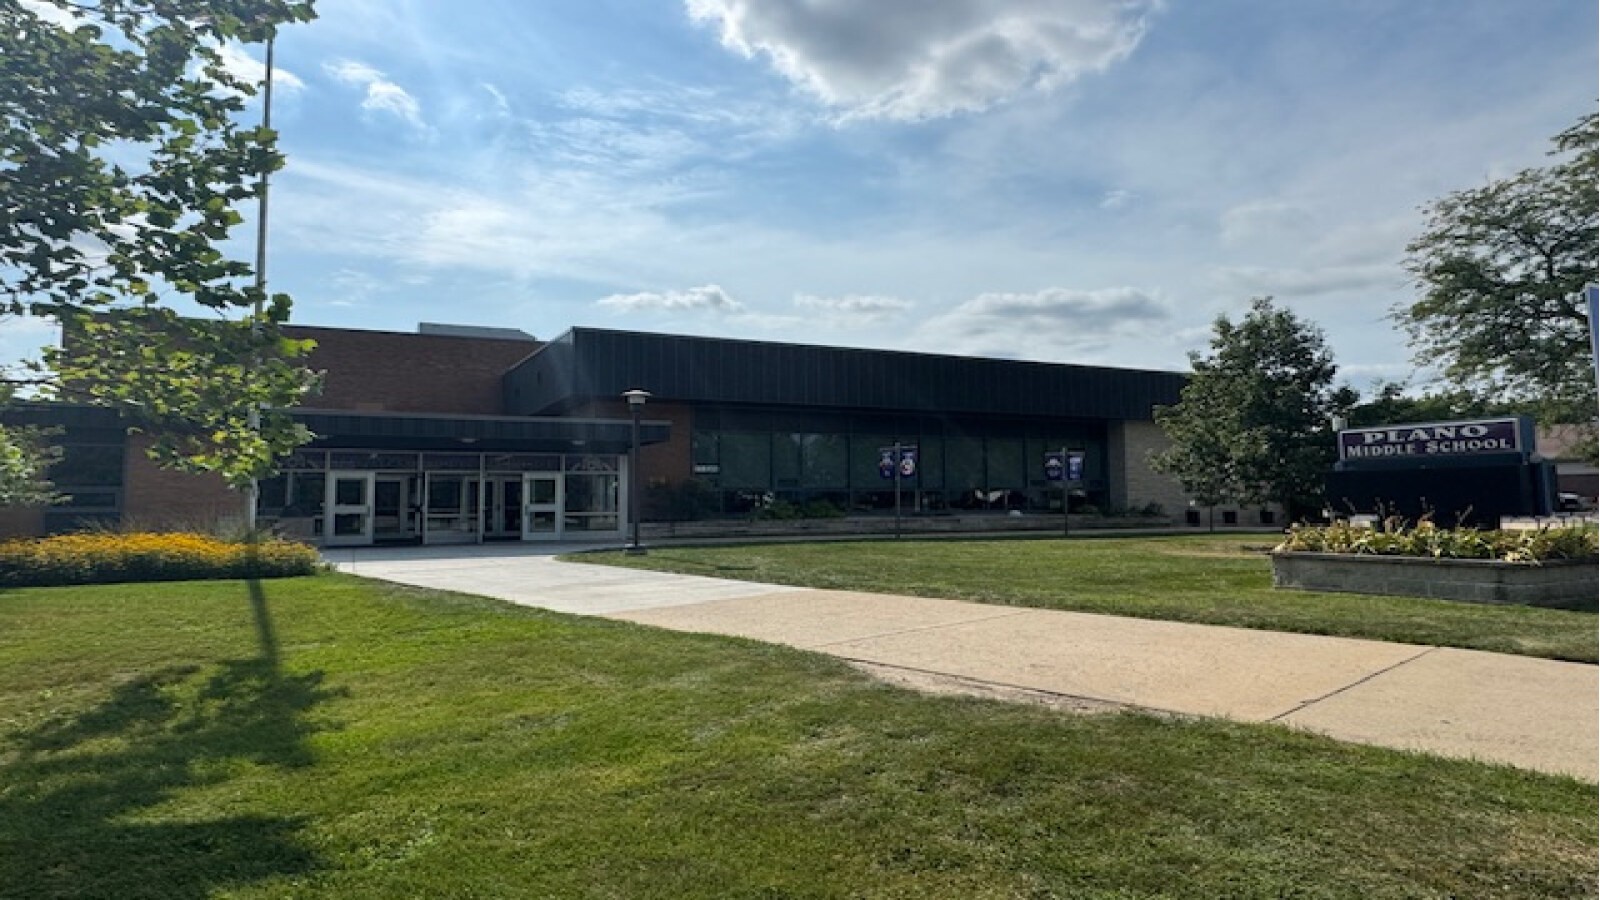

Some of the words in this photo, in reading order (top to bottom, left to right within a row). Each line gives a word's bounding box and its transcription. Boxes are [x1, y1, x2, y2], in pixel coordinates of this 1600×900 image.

[1364, 424, 1489, 443] PLANO
[1347, 444, 1415, 457] MIDDLE
[1425, 438, 1511, 453] SCHOOL
